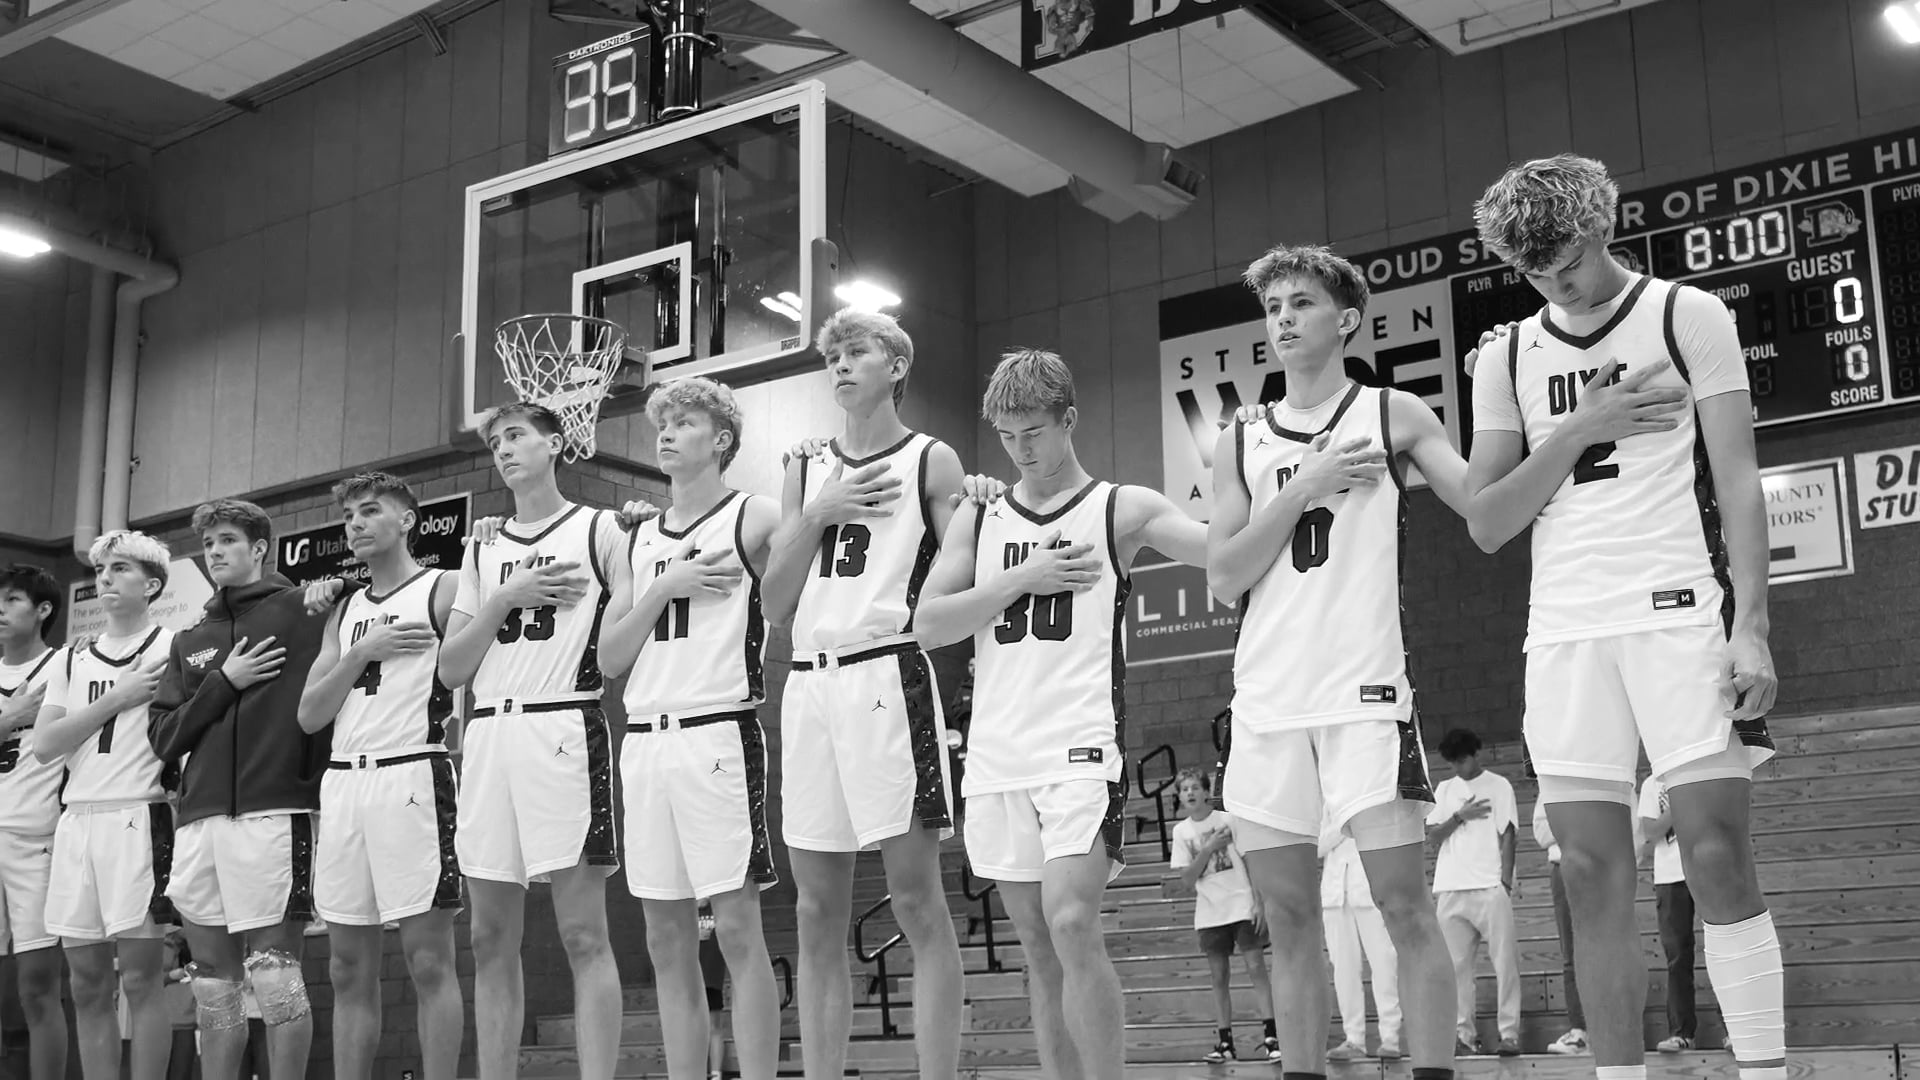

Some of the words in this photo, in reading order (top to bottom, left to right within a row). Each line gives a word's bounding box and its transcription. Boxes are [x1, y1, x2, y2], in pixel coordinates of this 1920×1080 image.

[569, 33, 631, 59] DAKTRONICS
[1352, 247, 1443, 285] OUD
[1662, 183, 1718, 220] OF
[1733, 152, 1852, 205] DIXIE
[1873, 137, 1918, 174] HI
[1892, 183, 1920, 203] PLYR
[1684, 211, 1787, 271] 8:00
[1467, 276, 1493, 293] PLYR
[1502, 269, 1521, 286] FLS
[1786, 249, 1855, 282] GUEST
[1709, 283, 1750, 301] RIOD
[1833, 277, 1864, 324] 0
[1180, 305, 1434, 380] STEEN
[1742, 343, 1779, 361] FOUL
[1825, 325, 1873, 347] FOULS
[1845, 344, 1870, 381] 0
[1830, 385, 1879, 406] SCORE
[1573, 440, 1620, 485] 2
[1865, 491, 1918, 522] STU
[316, 534, 348, 556] Utah
[819, 523, 871, 578] 13
[1292, 507, 1334, 573] 0
[497, 604, 557, 644] 33
[654, 597, 690, 641] 11
[994, 590, 1073, 645] 30
[1136, 621, 1207, 638] COMMERCIAL
[353, 660, 382, 696] 4
